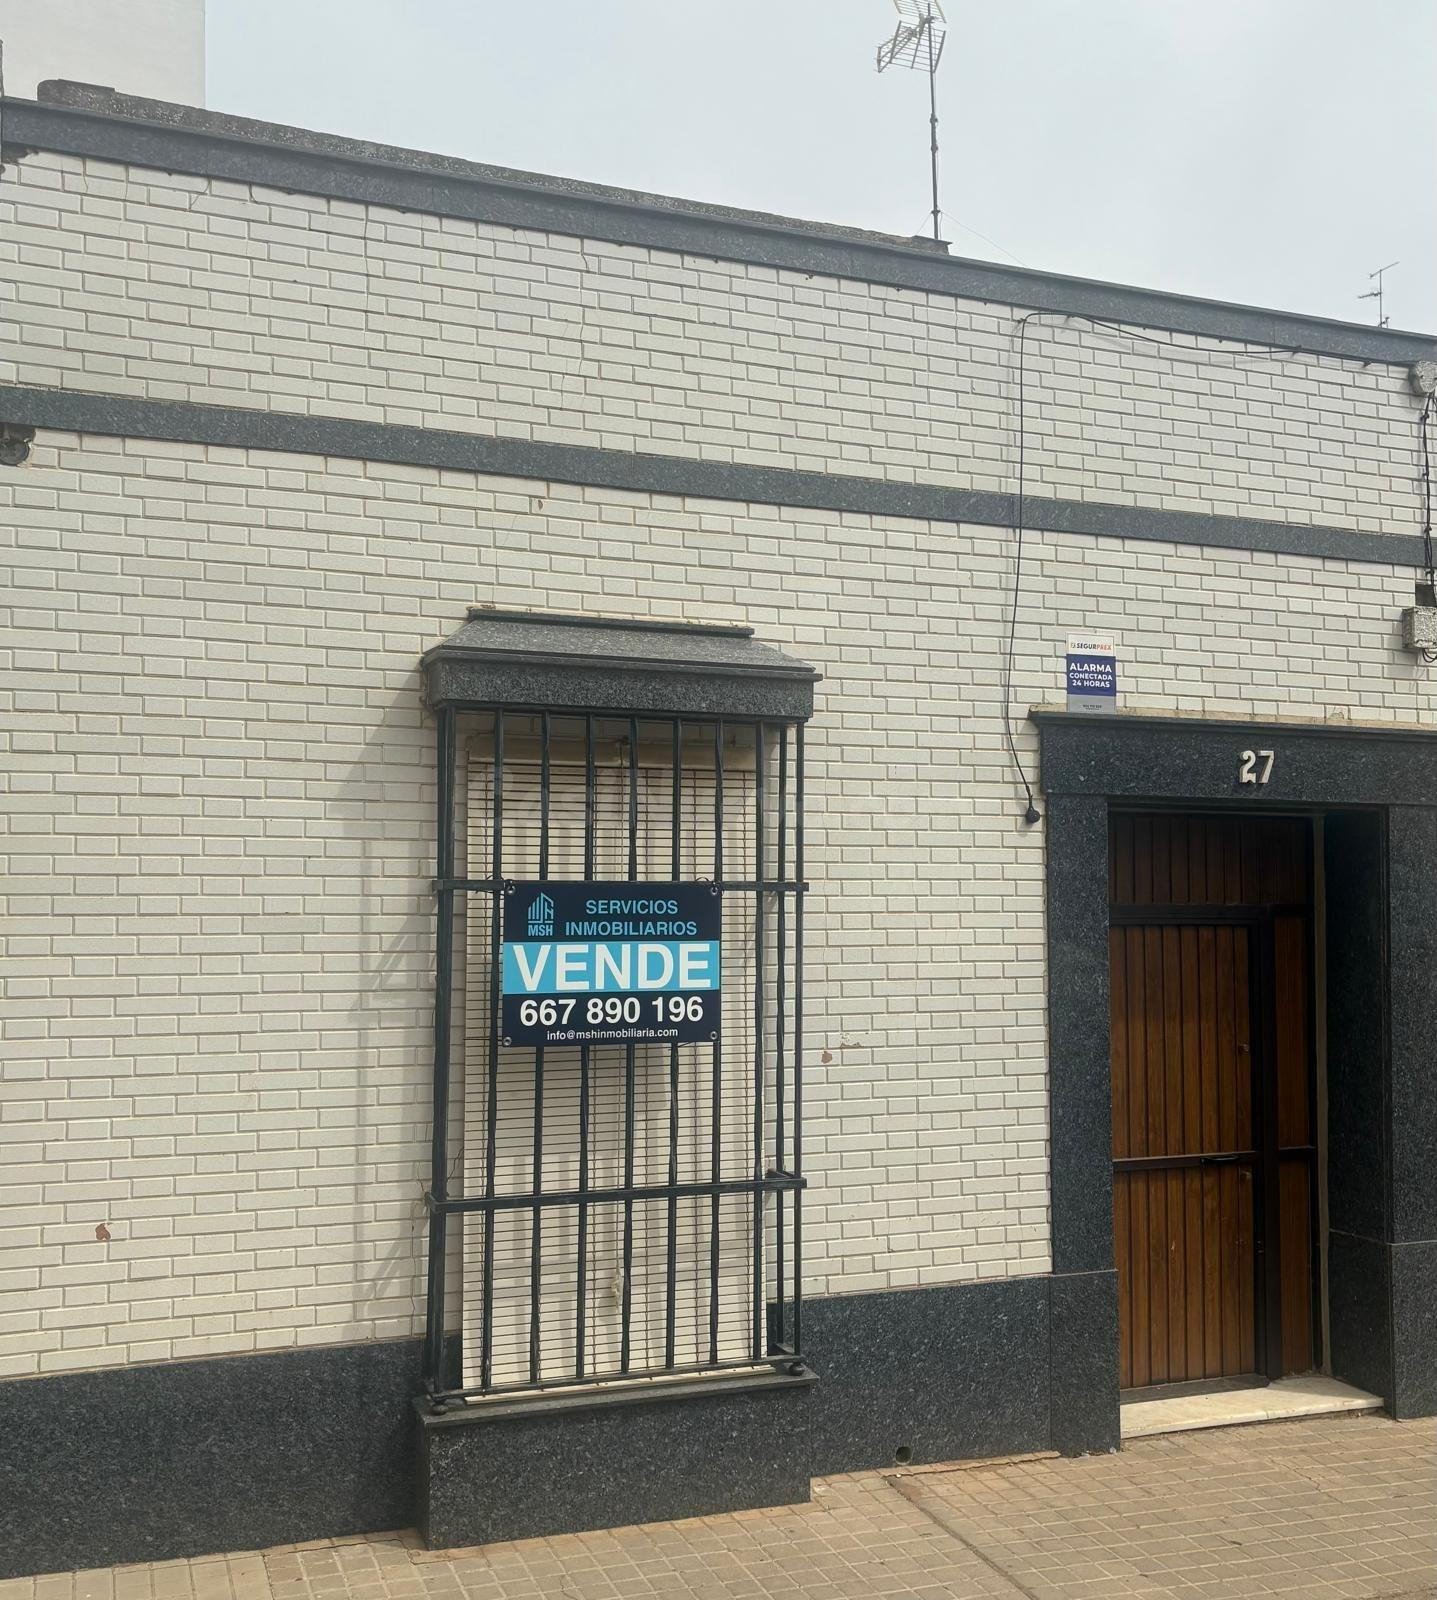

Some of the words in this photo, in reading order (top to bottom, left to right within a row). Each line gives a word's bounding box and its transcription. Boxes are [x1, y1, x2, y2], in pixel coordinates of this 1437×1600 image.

[1069, 662, 1112, 673] ALARMA
[1083, 680, 1110, 688] HORAS
[1239, 750, 1275, 784] 27
[585, 899, 679, 915] SERVICIOS
[527, 924, 553, 937] MSH
[565, 921, 698, 936] INMOBILIARIOS
[513, 943, 711, 991] VENDE
[520, 999, 577, 1027] 667
[586, 997, 641, 1024] 890
[651, 996, 704, 1022] 196
[546, 1028, 679, 1041] info@mshinmobiliaria.com
